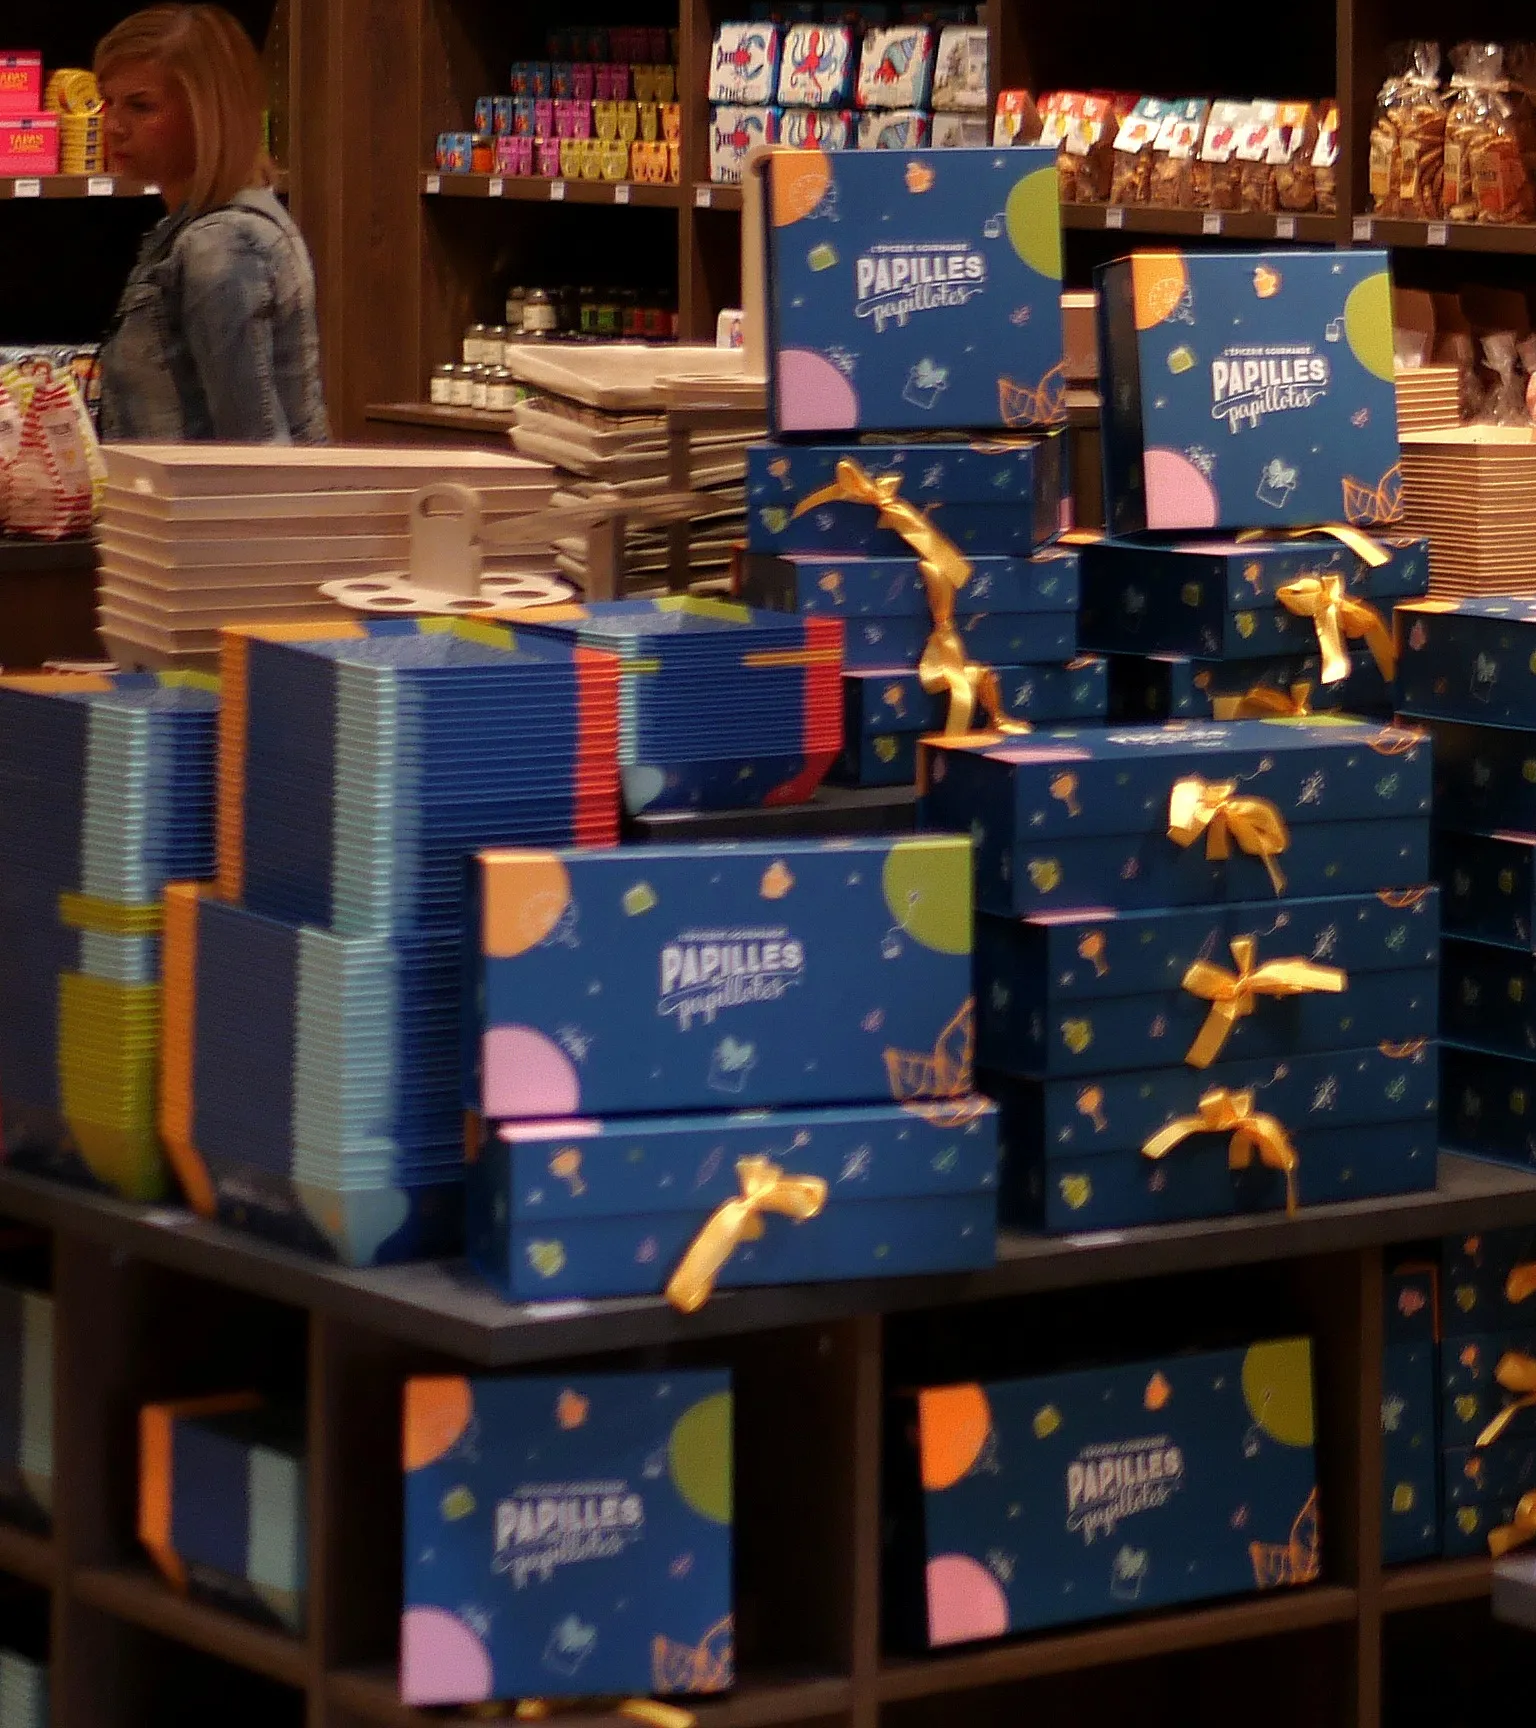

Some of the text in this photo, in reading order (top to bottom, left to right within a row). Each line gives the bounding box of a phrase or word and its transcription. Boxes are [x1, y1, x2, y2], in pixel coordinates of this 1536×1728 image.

[857, 256, 984, 300] PAPILLES
[855, 282, 983, 333] papillotes
[1212, 358, 1327, 402] PAPILLES
[1211, 384, 1327, 434] papillotes
[661, 941, 804, 996] PAPILLES
[1067, 1446, 1182, 1513] PAPILLES
[494, 1493, 642, 1553] PAPILLES
